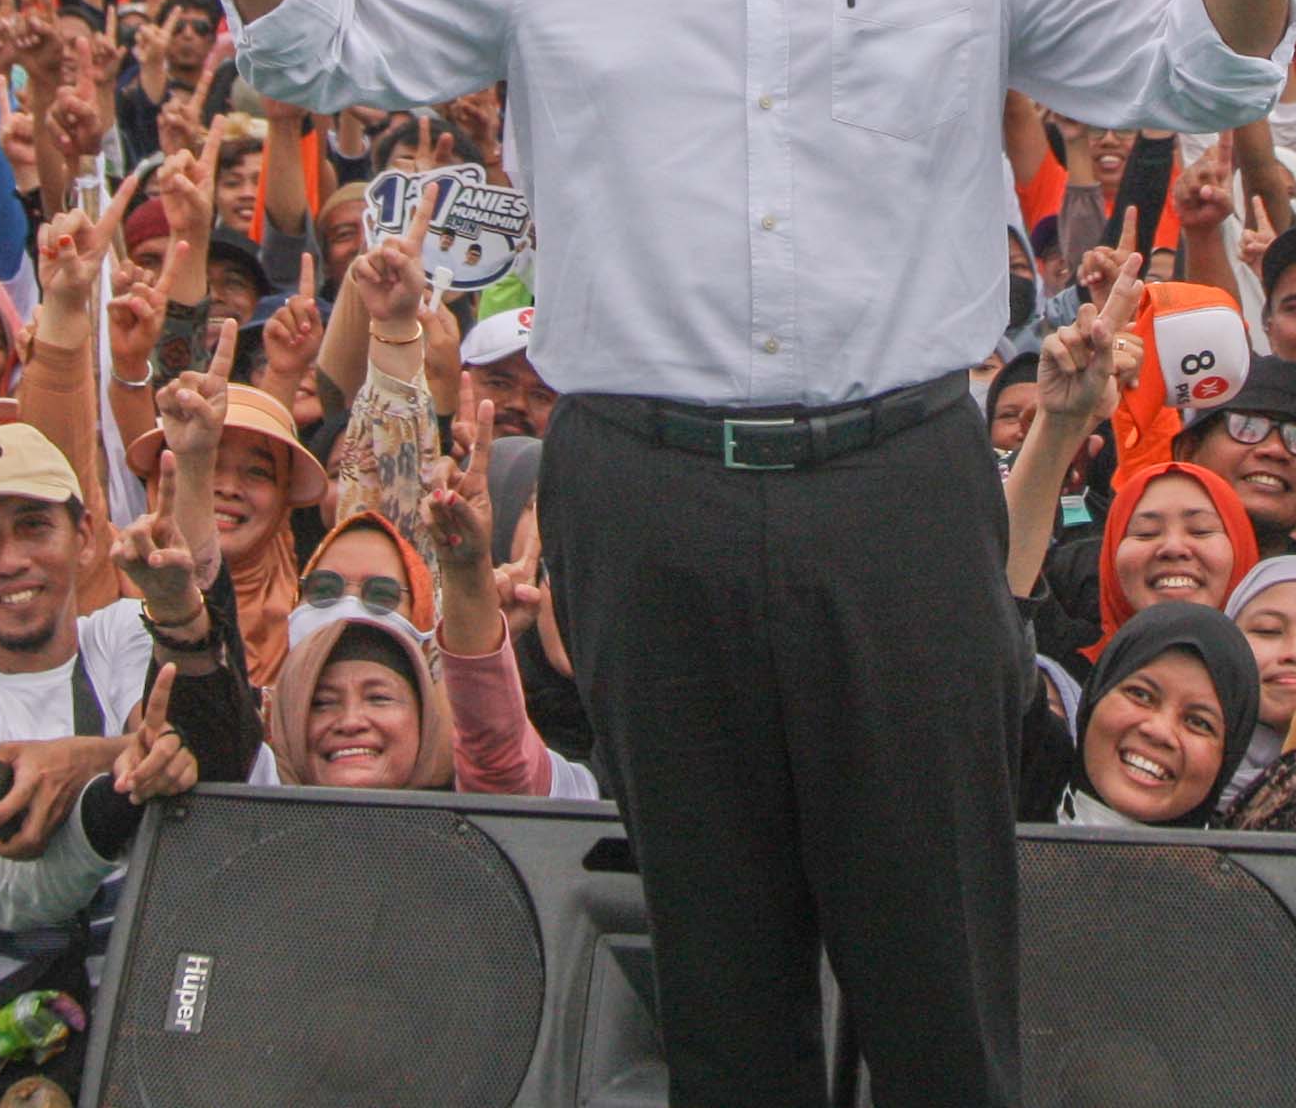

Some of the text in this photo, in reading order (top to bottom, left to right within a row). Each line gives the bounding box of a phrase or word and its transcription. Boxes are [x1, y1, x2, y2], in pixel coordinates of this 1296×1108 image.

[450, 205, 526, 231] MUHAIMIN
[456, 187, 530, 220] ANIES
[1181, 350, 1215, 376] 8
[174, 955, 210, 1032] Hüper
